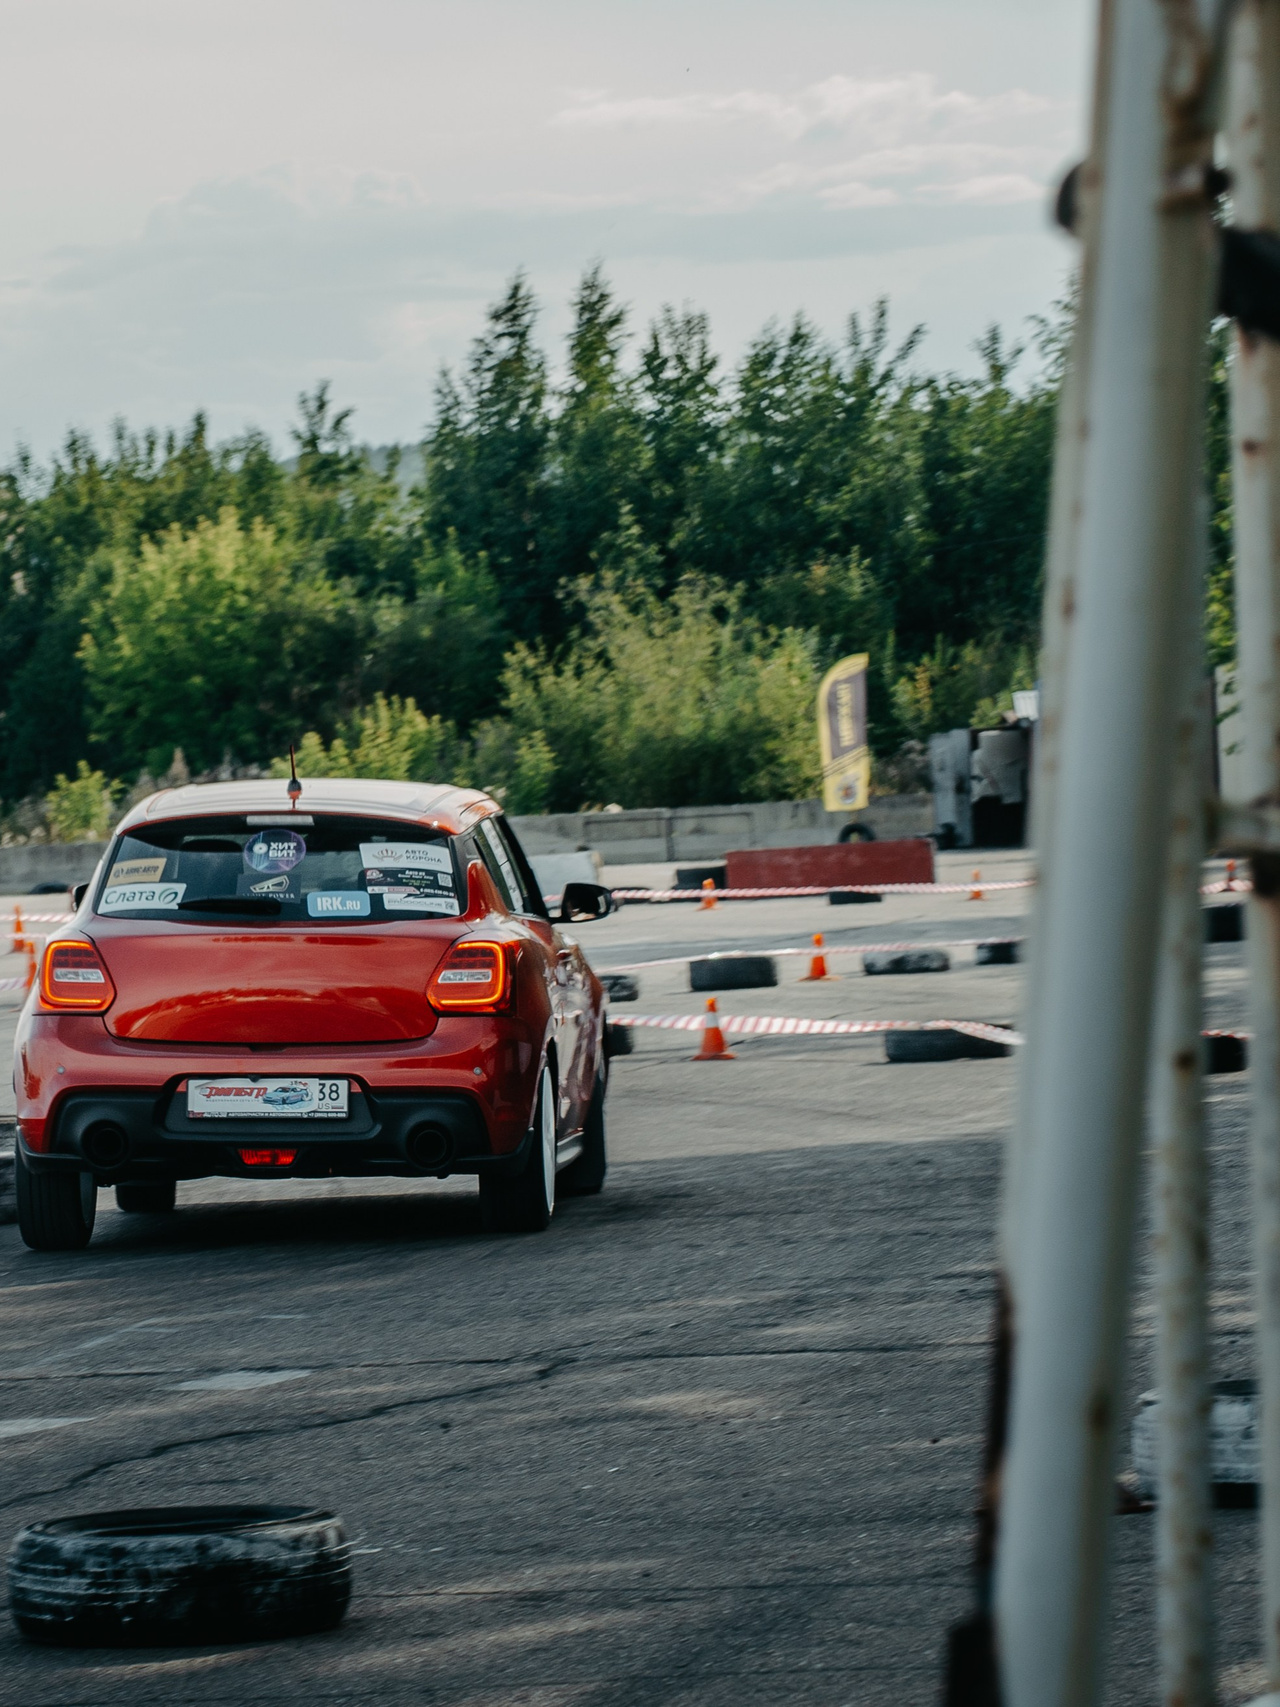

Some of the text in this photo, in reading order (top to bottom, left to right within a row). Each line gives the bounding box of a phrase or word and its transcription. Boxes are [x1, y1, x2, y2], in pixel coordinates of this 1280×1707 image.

[270, 842, 297, 850] ХИТ
[405, 855, 442, 864] КОРОНА
[105, 890, 156, 905] Слата
[316, 896, 361, 911] IRK.RU
[318, 1082, 340, 1101] 38
